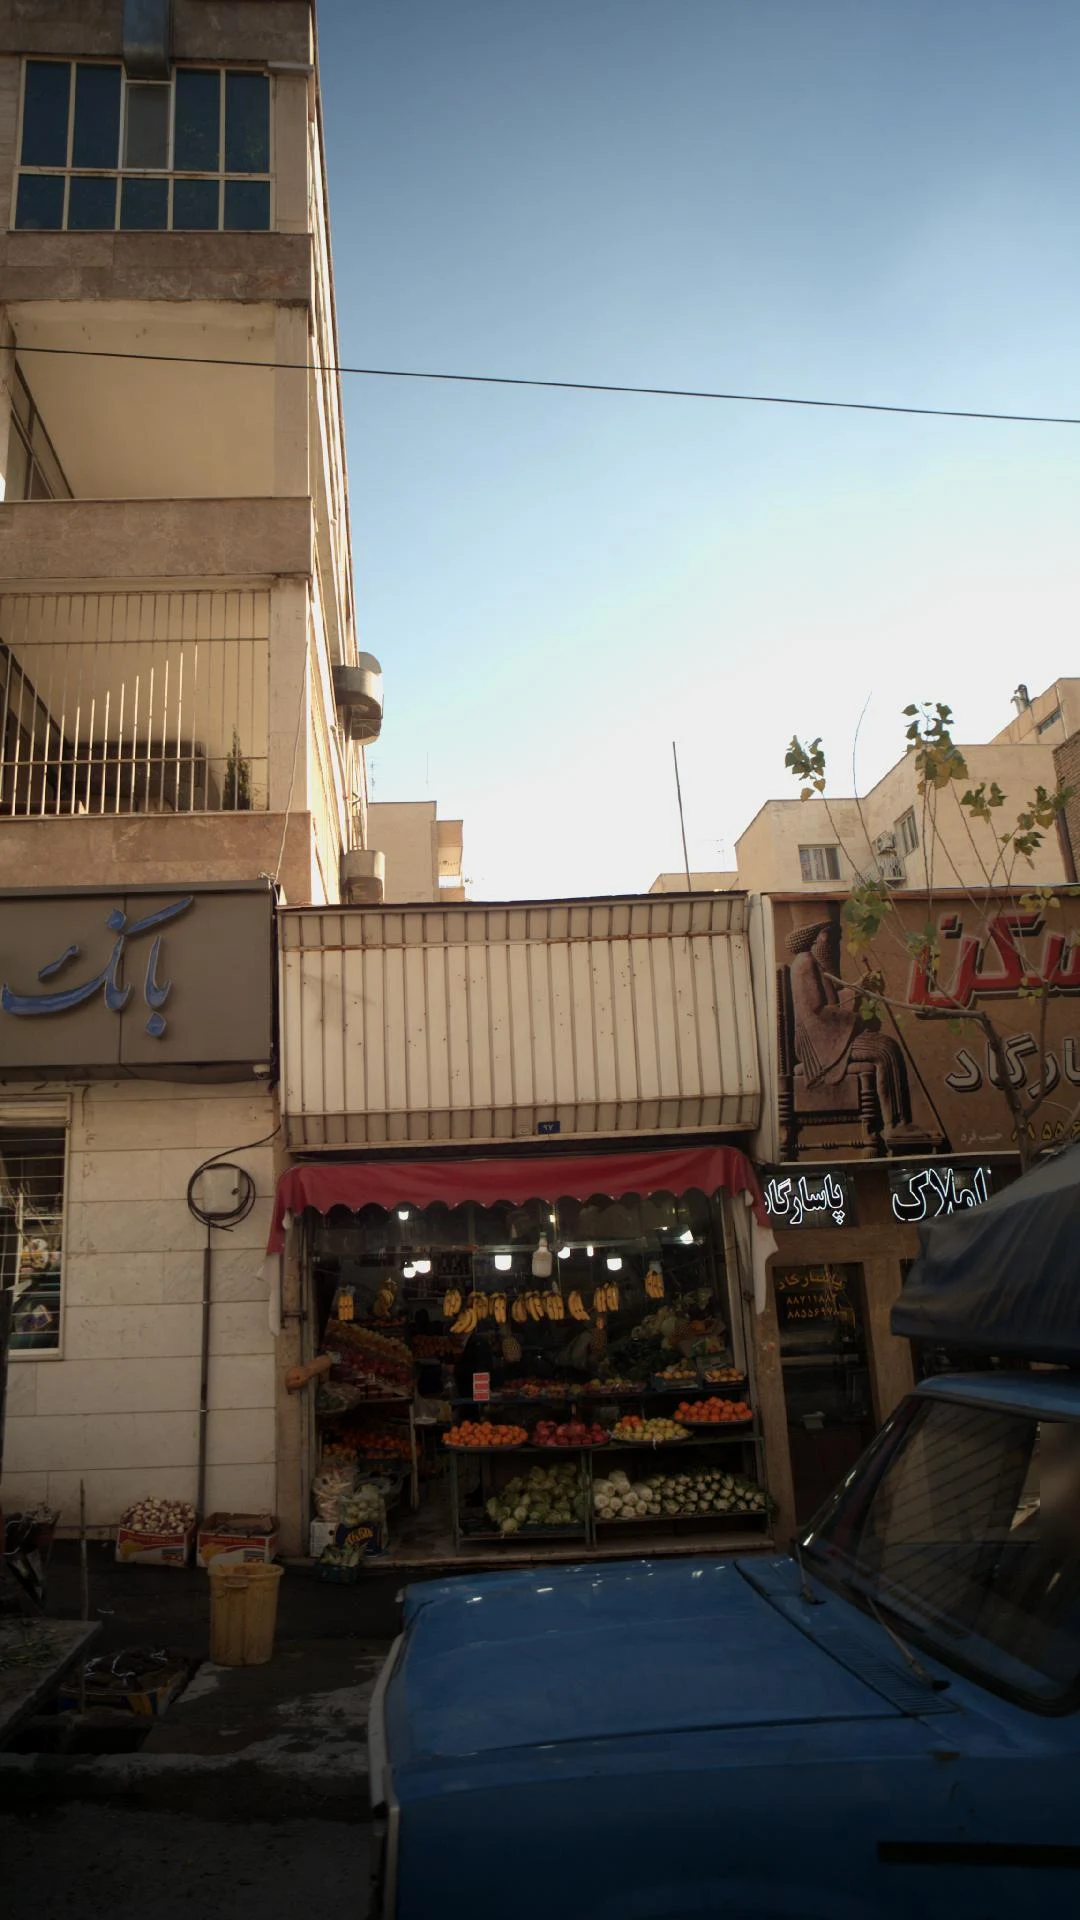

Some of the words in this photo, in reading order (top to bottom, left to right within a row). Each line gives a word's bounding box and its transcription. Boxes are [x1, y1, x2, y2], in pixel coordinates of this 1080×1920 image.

[908, 911, 1080, 1009] سکن
[945, 1032, 1080, 1098] ارگاد
[892, 1167, 988, 1221] املاک
